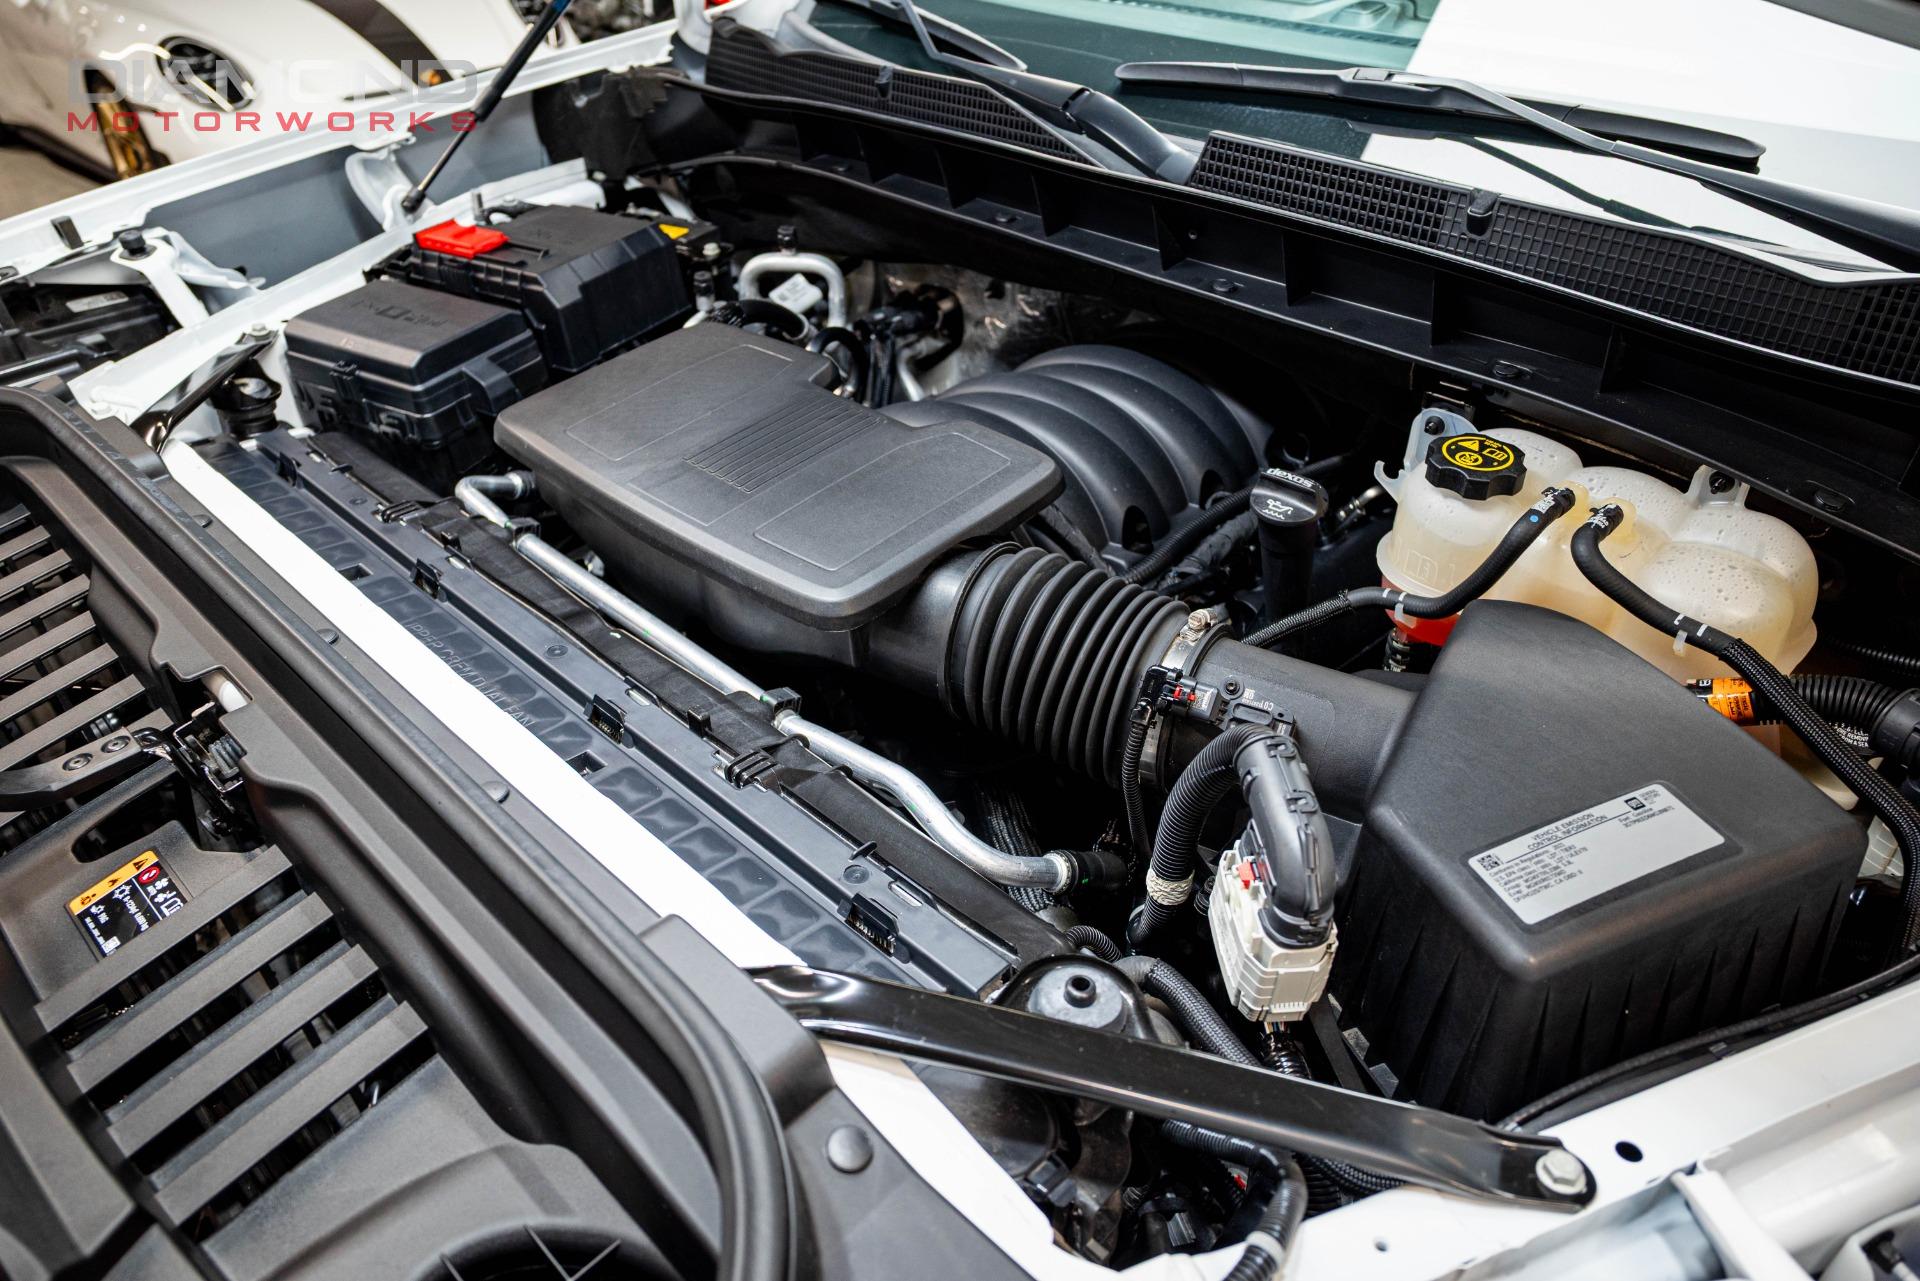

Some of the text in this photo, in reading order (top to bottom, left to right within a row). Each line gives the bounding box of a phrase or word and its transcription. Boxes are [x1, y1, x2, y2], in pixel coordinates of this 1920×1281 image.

[1266, 468, 1313, 488] dexos
[1527, 834, 1562, 850] CONTROL
[1562, 815, 1609, 836] INFORMATION
[1532, 813, 1595, 841] VEHICLE EMISSION
